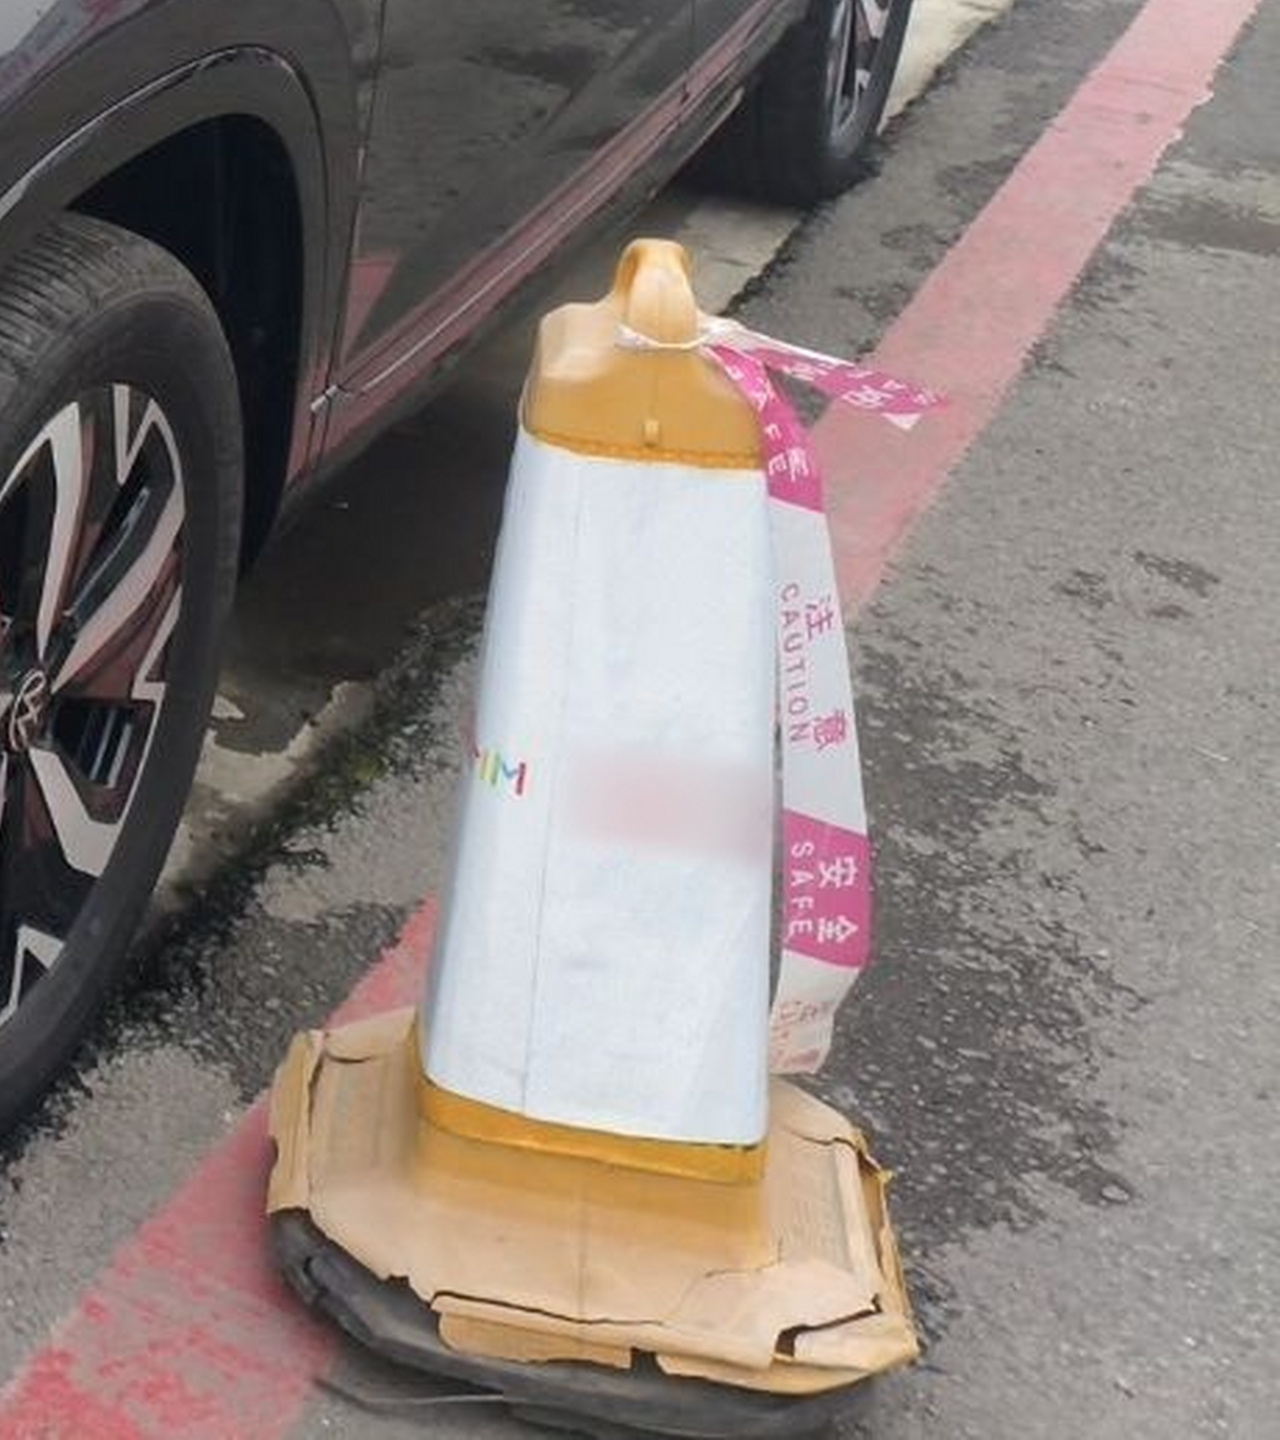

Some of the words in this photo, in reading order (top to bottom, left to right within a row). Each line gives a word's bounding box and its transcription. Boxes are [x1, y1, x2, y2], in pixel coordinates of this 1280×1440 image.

[780, 581, 810, 744] CAUTION
[789, 839, 816, 937] SAFE
[817, 855, 860, 945] 安全
